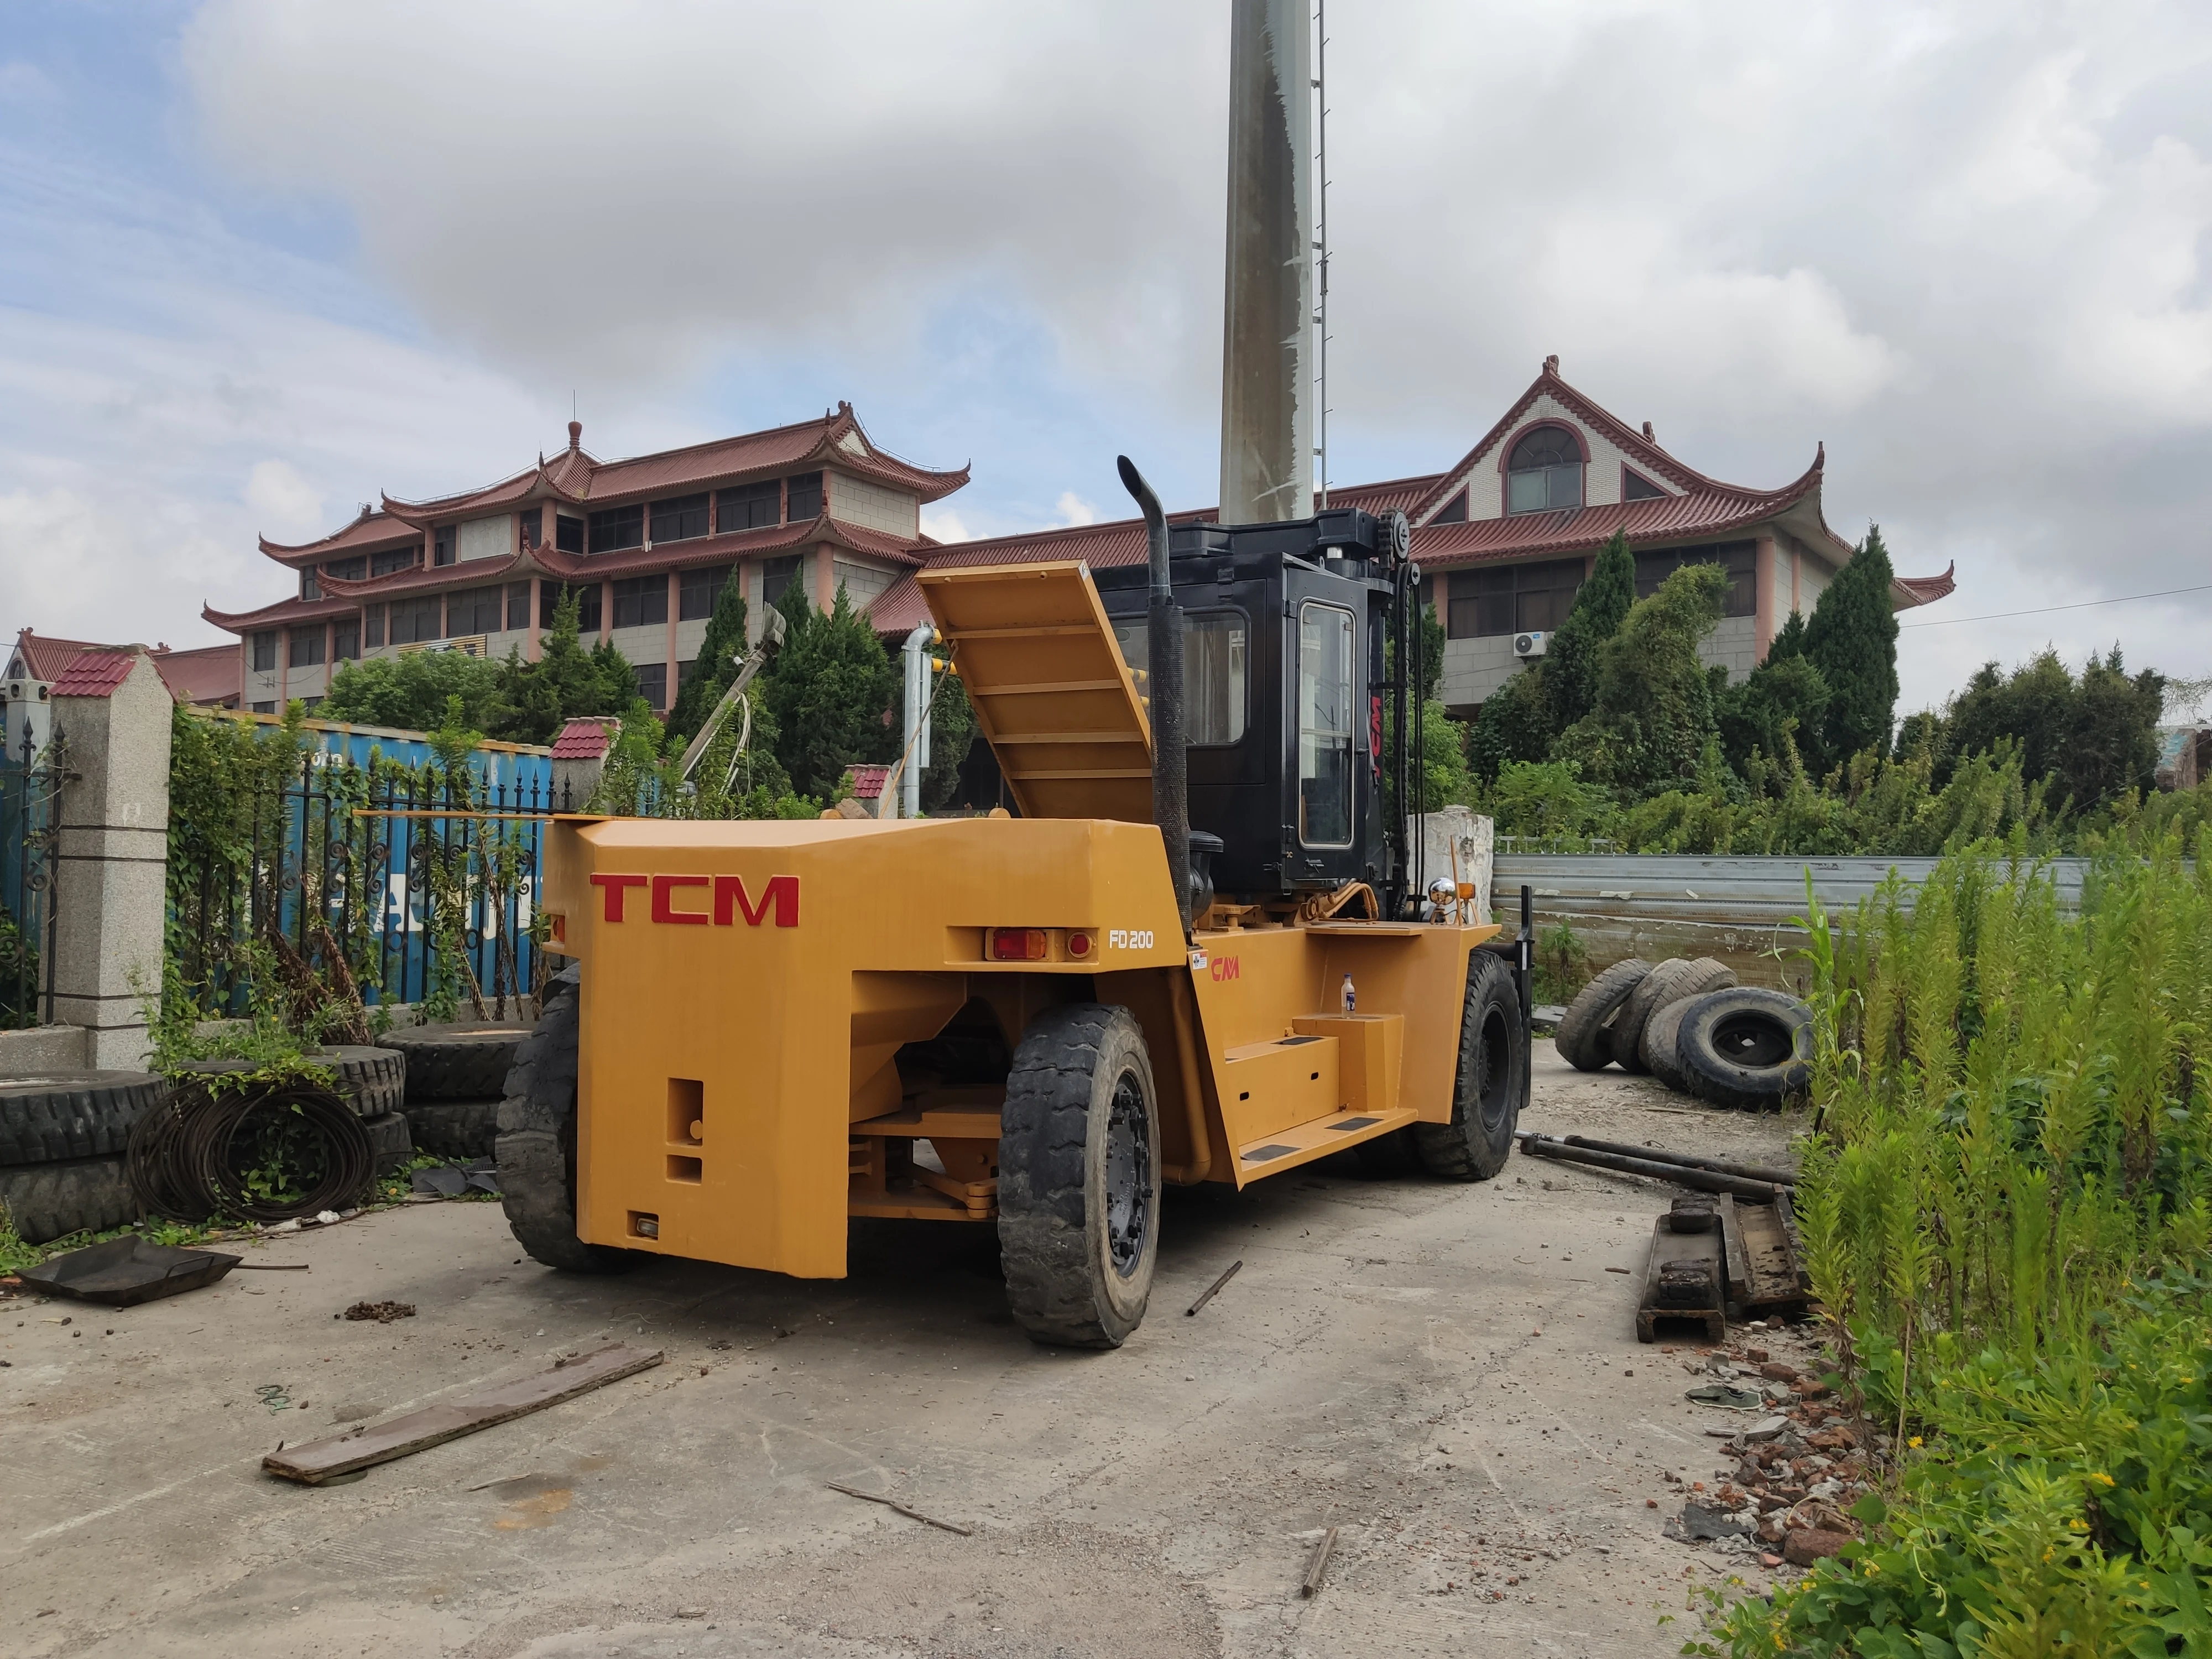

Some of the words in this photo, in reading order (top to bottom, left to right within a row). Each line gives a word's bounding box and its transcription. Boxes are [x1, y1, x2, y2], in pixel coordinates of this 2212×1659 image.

[1371, 696, 1381, 778] CM
[590, 874, 799, 927] TCM
[1109, 930, 1127, 949] FD
[1130, 930, 1154, 949] 200
